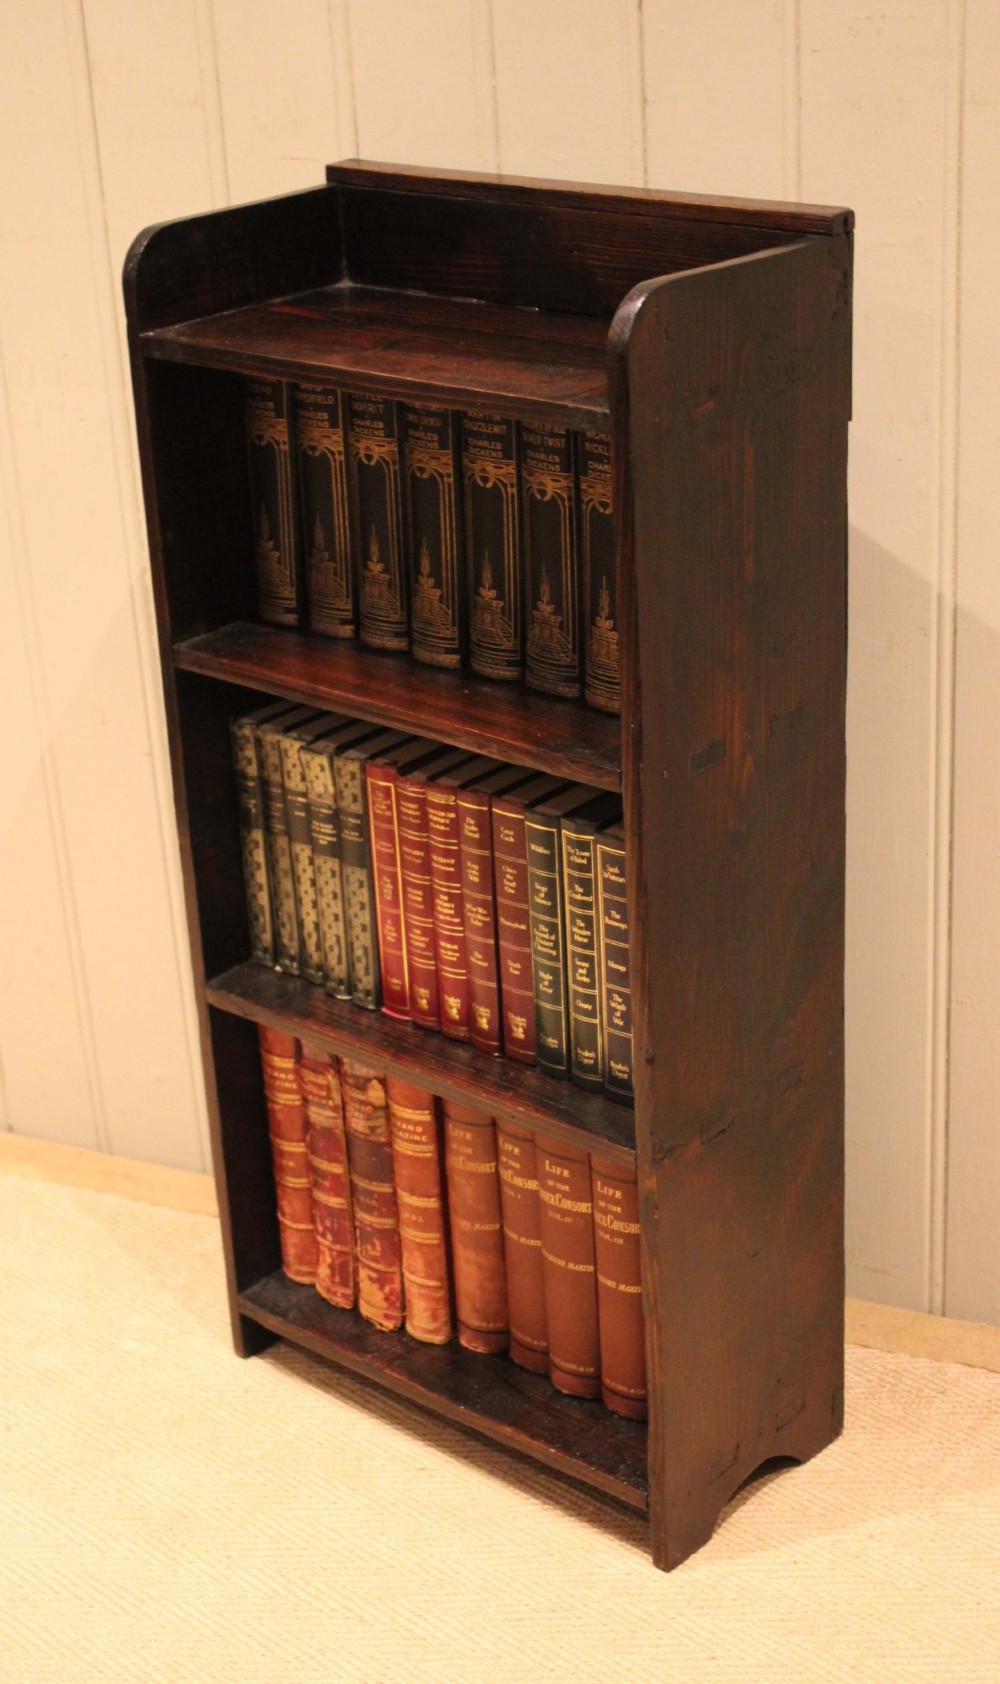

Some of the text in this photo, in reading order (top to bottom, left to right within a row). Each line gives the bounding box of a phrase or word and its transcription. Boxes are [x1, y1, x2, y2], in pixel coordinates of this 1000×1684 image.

[587, 460, 612, 473] CHARL
[574, 884, 584, 893] The
[609, 909, 621, 920] The
[576, 919, 586, 927] The
[611, 993, 624, 1003] The
[499, 1136, 520, 1155] LIFE
[545, 1160, 570, 1178] LIFE
[508, 1169, 539, 1190] CONSOR
[555, 1182, 570, 1192] THE
[597, 1181, 623, 1199] LIFE
[555, 1193, 593, 1214] CONSORT
[607, 1203, 623, 1213] THE
[607, 1214, 641, 1234] CONSOR
[519, 1236, 542, 1247] MARTI
[567, 1261, 595, 1272] MARTIN
[618, 1283, 642, 1294] MARTI
